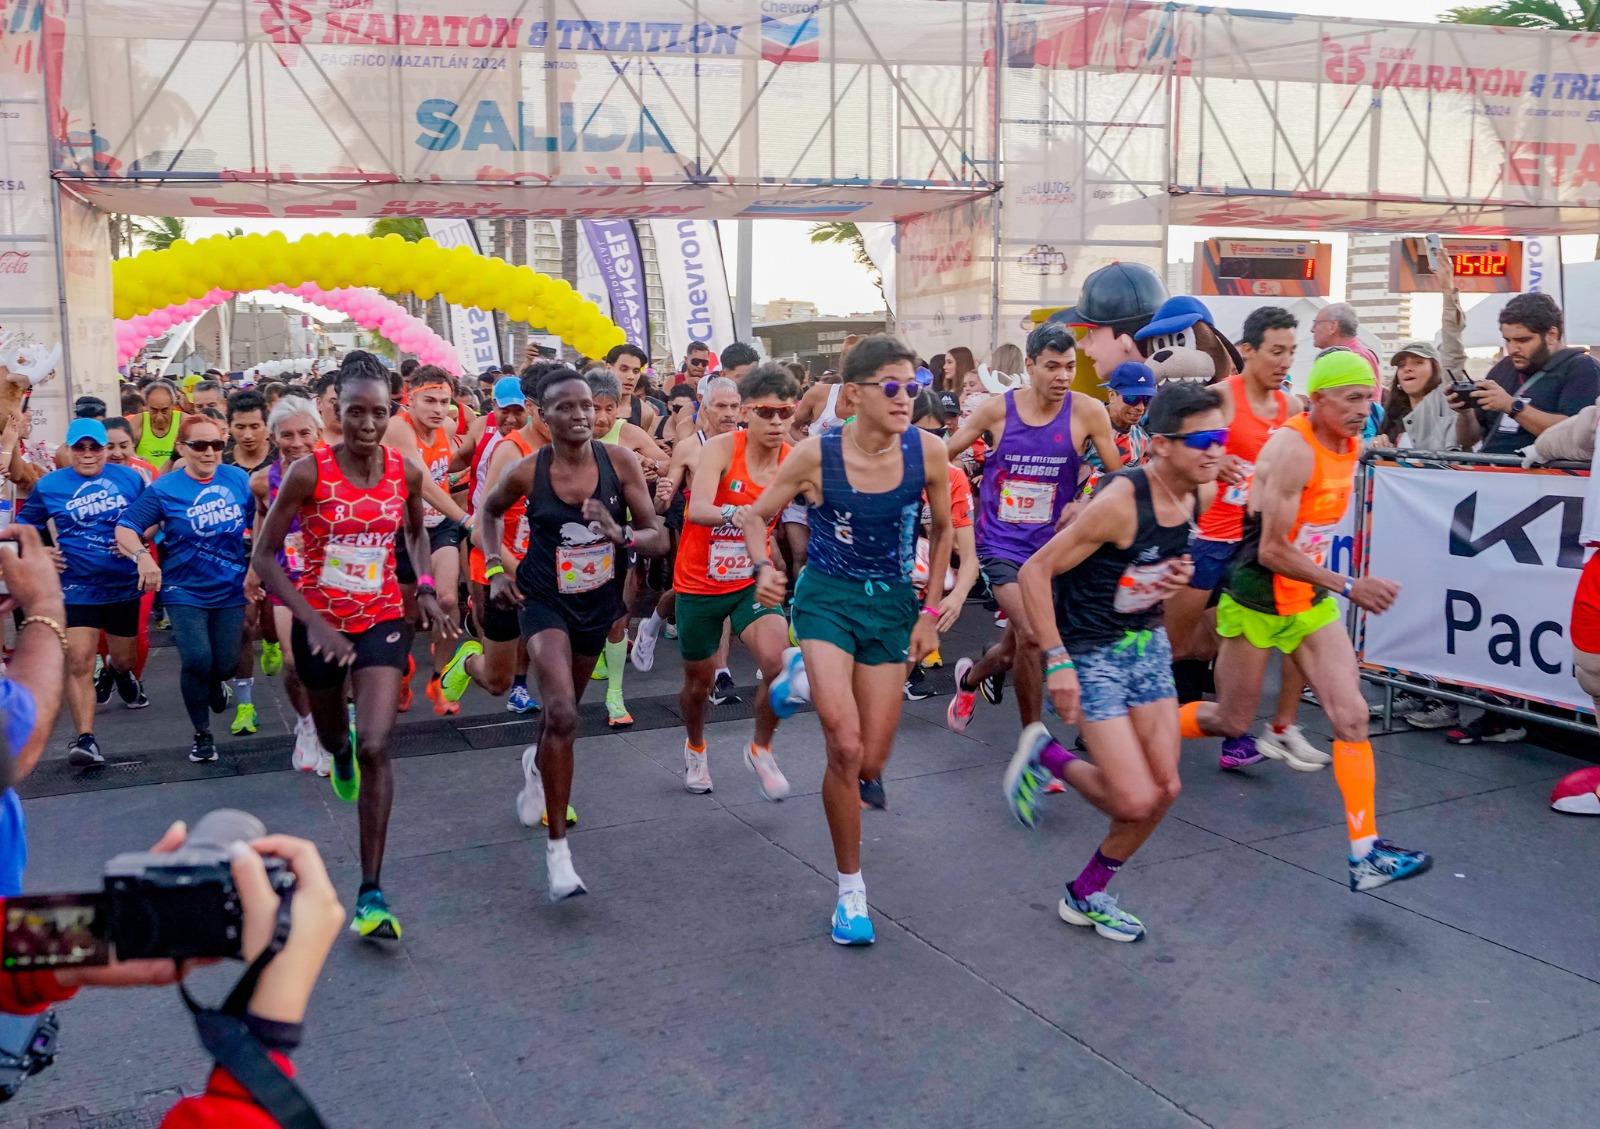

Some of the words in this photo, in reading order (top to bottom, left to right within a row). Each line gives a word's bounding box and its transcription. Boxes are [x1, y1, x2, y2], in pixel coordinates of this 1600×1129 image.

[760, 0, 821, 14] Chevron
[528, 22, 549, 48] &
[472, 57, 506, 70] 2024
[415, 98, 677, 154] SALIDA
[673, 219, 714, 342] Chevron
[1010, 464, 1060, 476] PEGASOS
[65, 489, 109, 510] GRUPO
[77, 494, 128, 520] PINSA
[186, 499, 226, 518] GRUPO
[1016, 495, 1035, 508] 19
[198, 503, 243, 529] PINSA
[325, 531, 397, 547] KENYA
[344, 563, 366, 579] 12
[582, 561, 596, 575] 4
[1445, 588, 1577, 678] Pac
